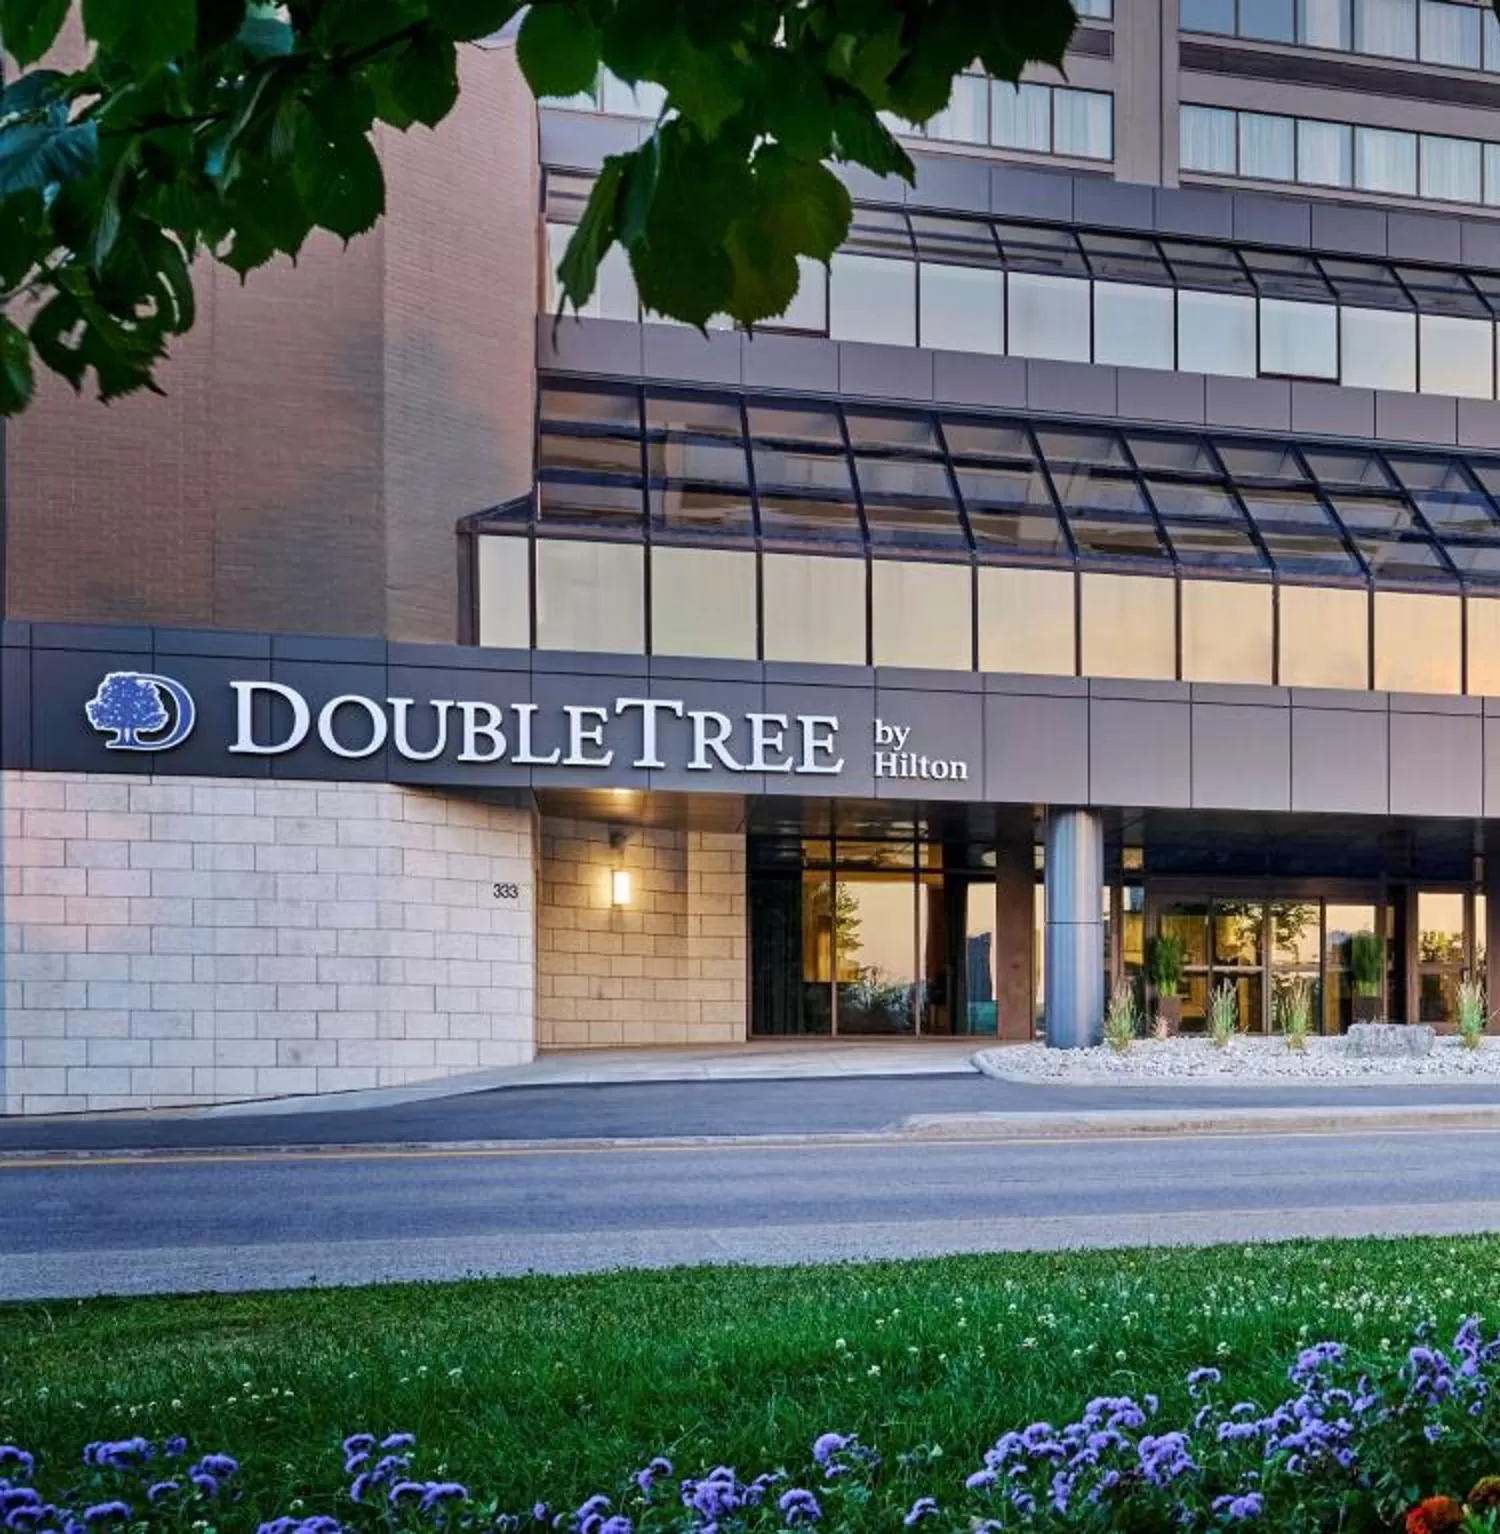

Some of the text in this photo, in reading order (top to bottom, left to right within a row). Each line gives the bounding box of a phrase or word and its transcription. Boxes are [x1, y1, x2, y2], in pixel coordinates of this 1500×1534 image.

[874, 719, 912, 752] by
[874, 751, 969, 780] Hilton
[493, 883, 519, 899] 333
